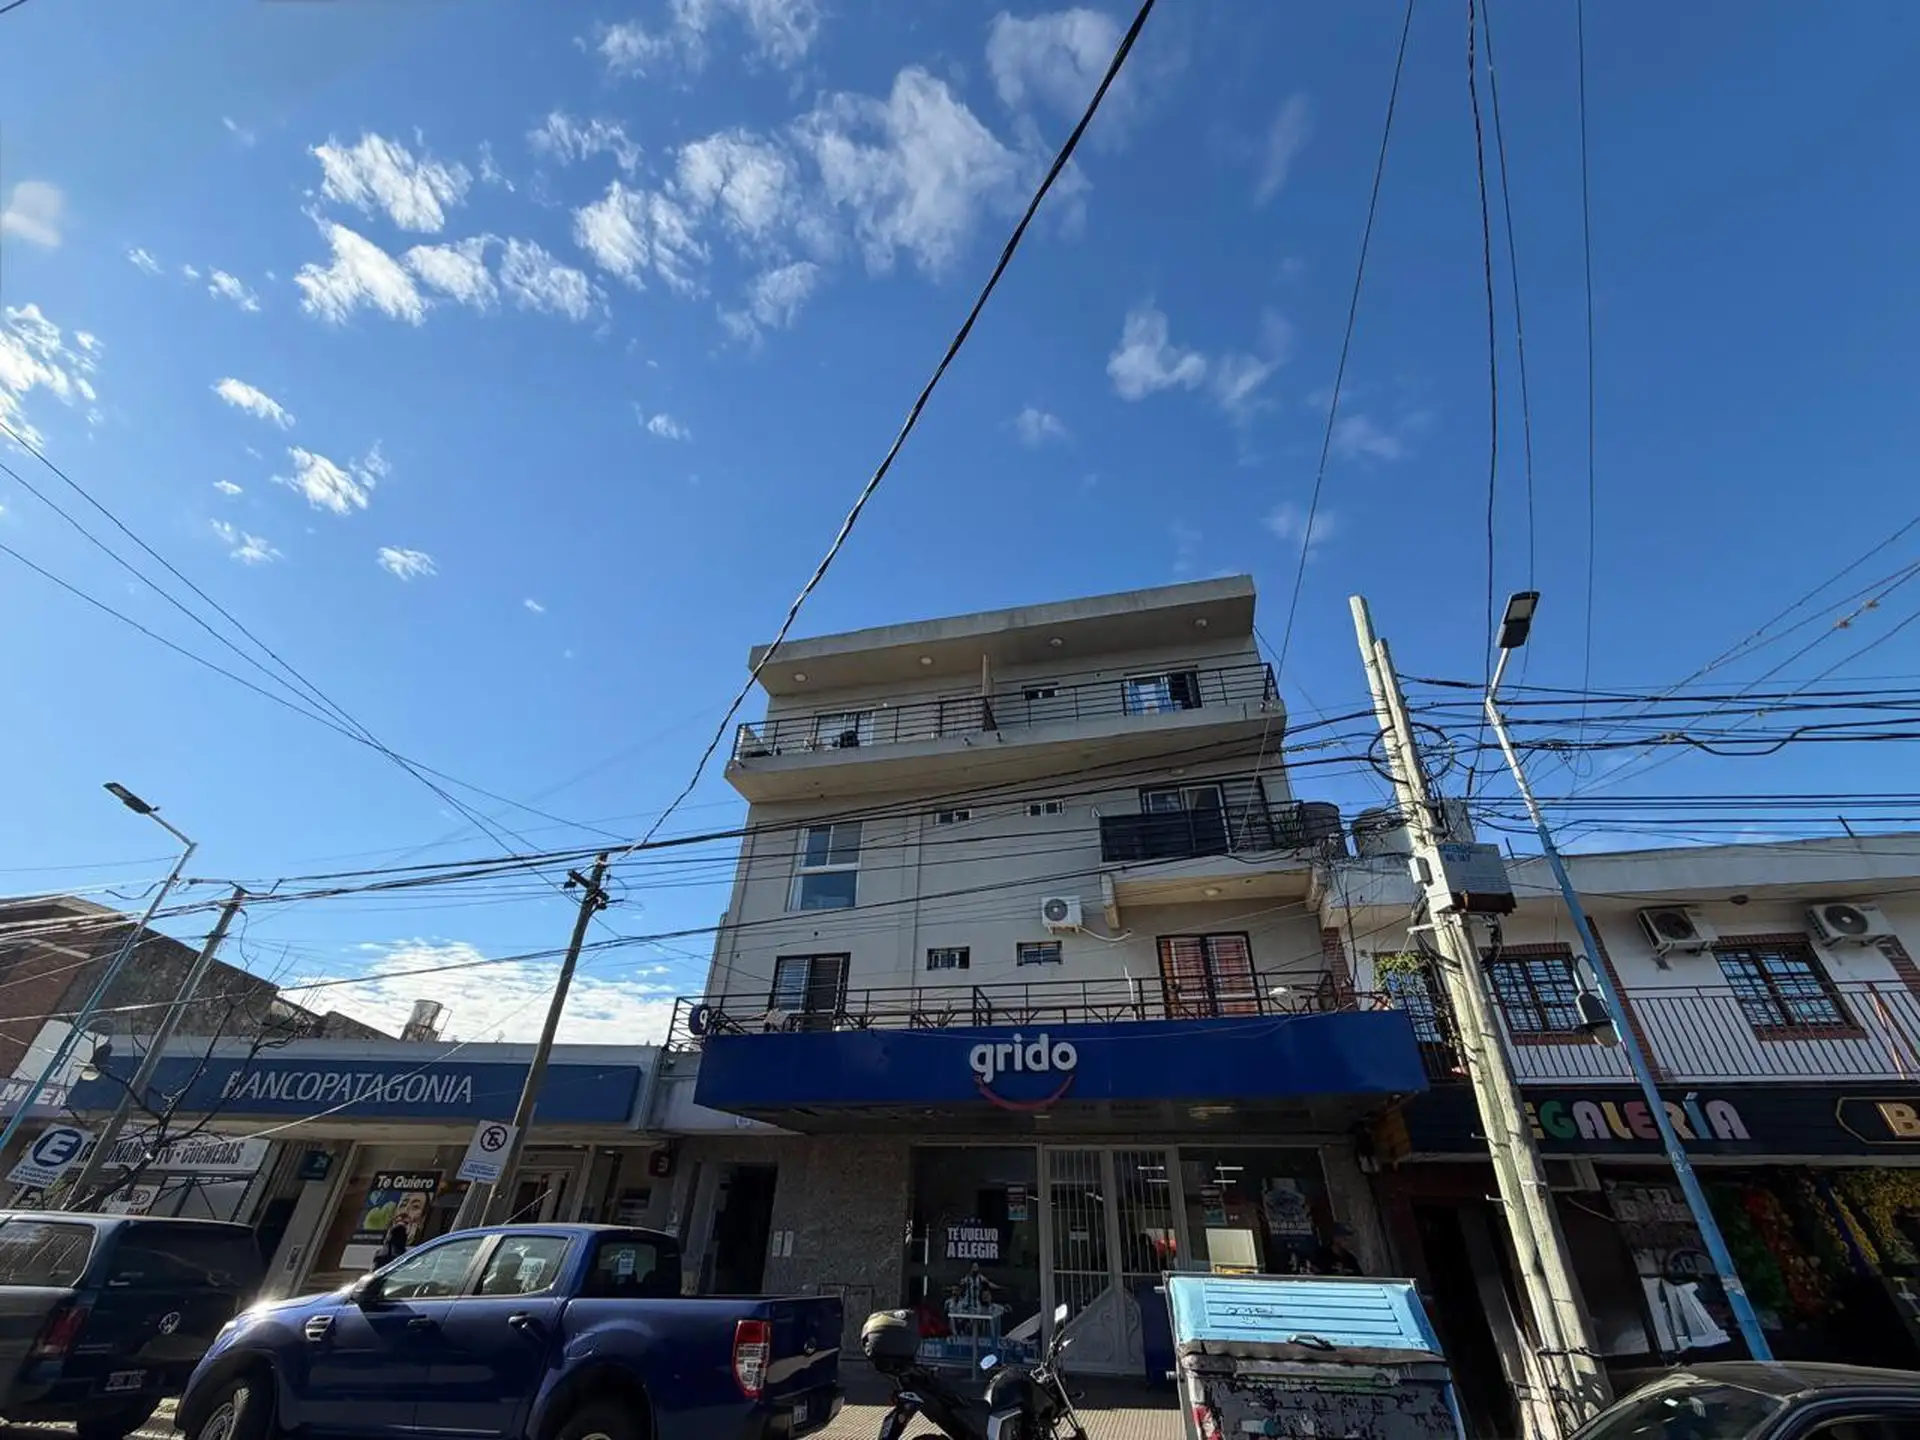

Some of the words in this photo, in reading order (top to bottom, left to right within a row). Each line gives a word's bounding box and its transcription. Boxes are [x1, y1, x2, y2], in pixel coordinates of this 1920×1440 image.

[969, 1033, 1077, 1083] grido
[376, 1175, 390, 1189] Te
[393, 1175, 434, 1189] Quiero
[960, 1227, 998, 1241] VUELVO
[946, 1241, 956, 1258] A
[957, 1241, 999, 1259] ELEGIR
